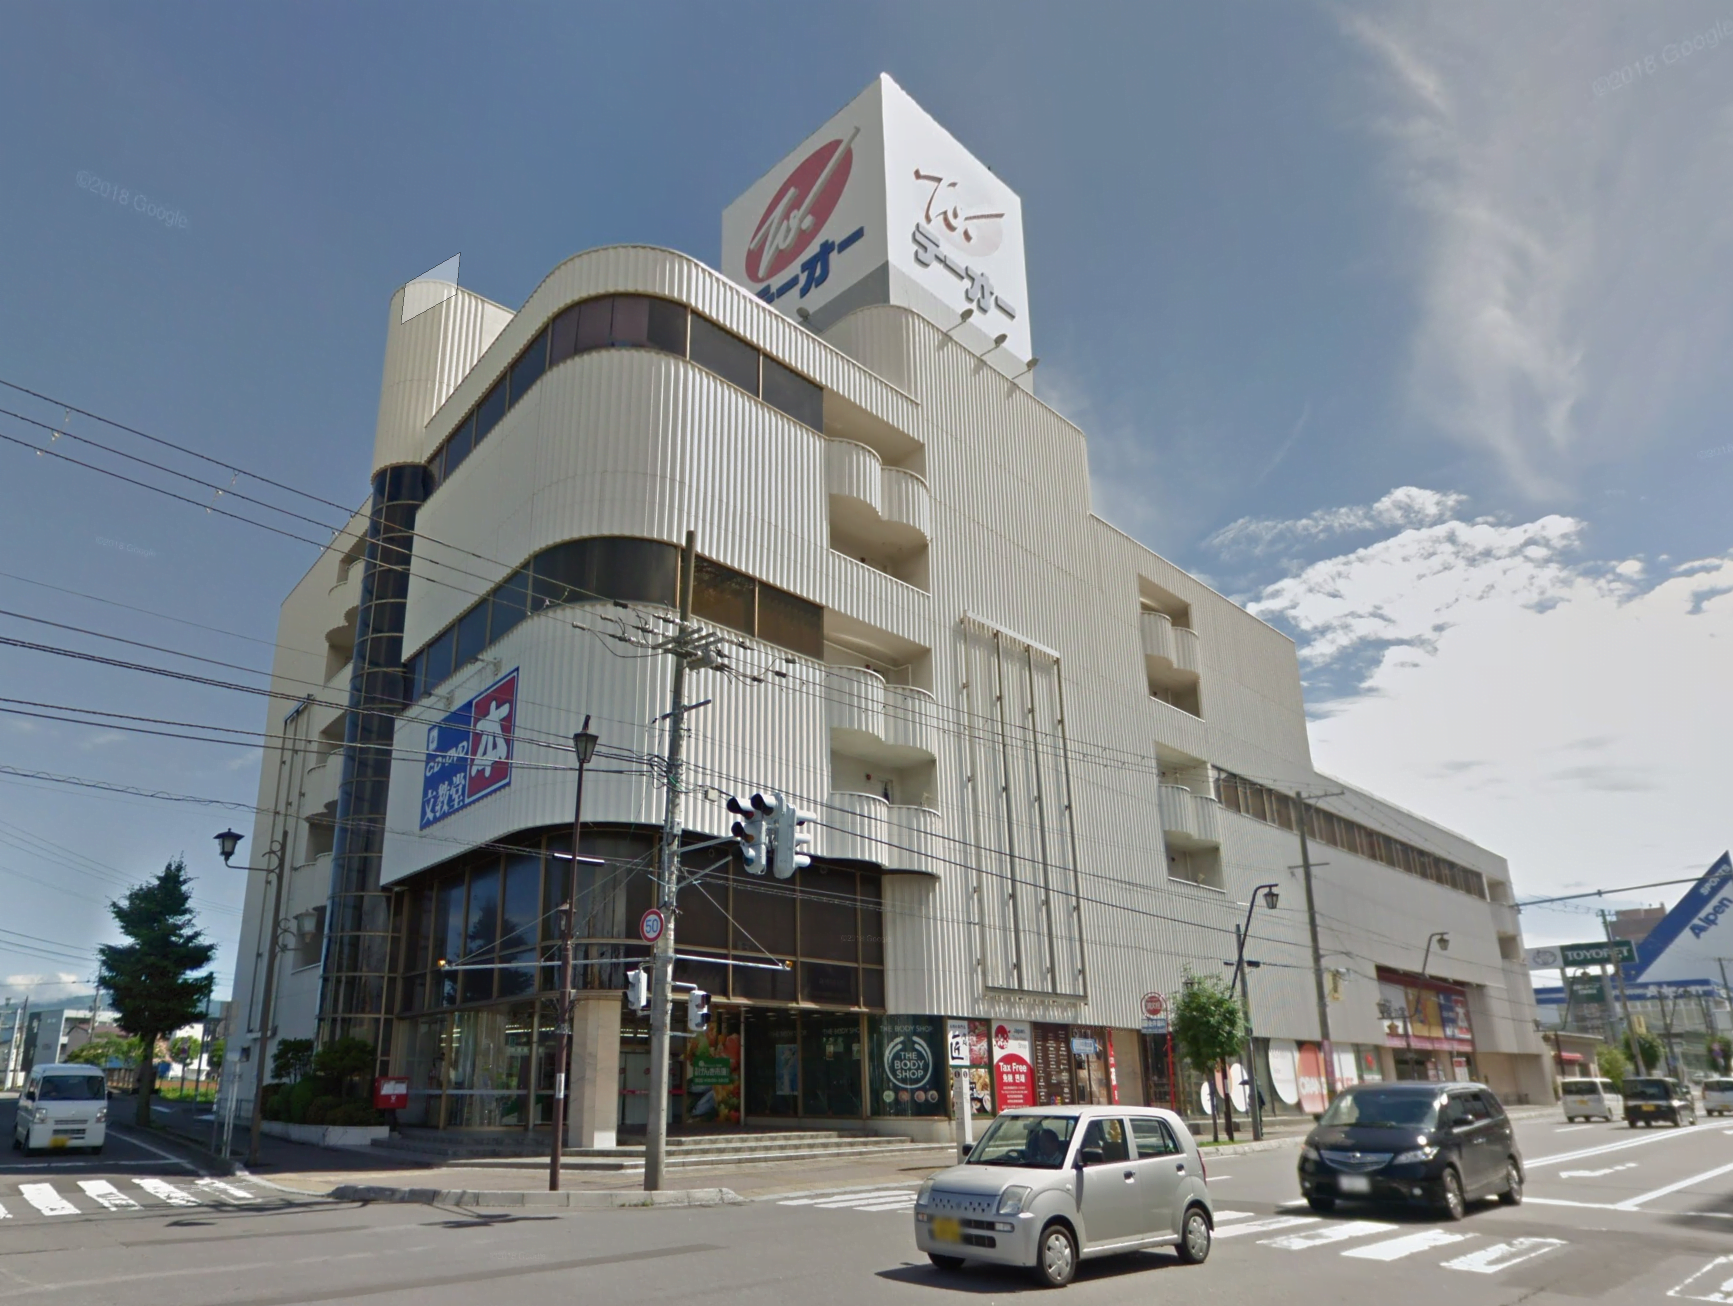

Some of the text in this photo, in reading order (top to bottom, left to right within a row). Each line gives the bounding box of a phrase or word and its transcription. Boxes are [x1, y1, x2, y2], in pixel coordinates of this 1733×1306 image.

[911, 221, 1017, 322] テーオー
[421, 772, 466, 826] 文教堂
[1689, 896, 1733, 940] Alpen
[645, 917, 659, 934] 50
[900, 1051, 918, 1060] THE
[894, 1060, 925, 1070] BODY
[999, 1062, 1027, 1072] Tax Free
[896, 1070, 924, 1079] SHOP
